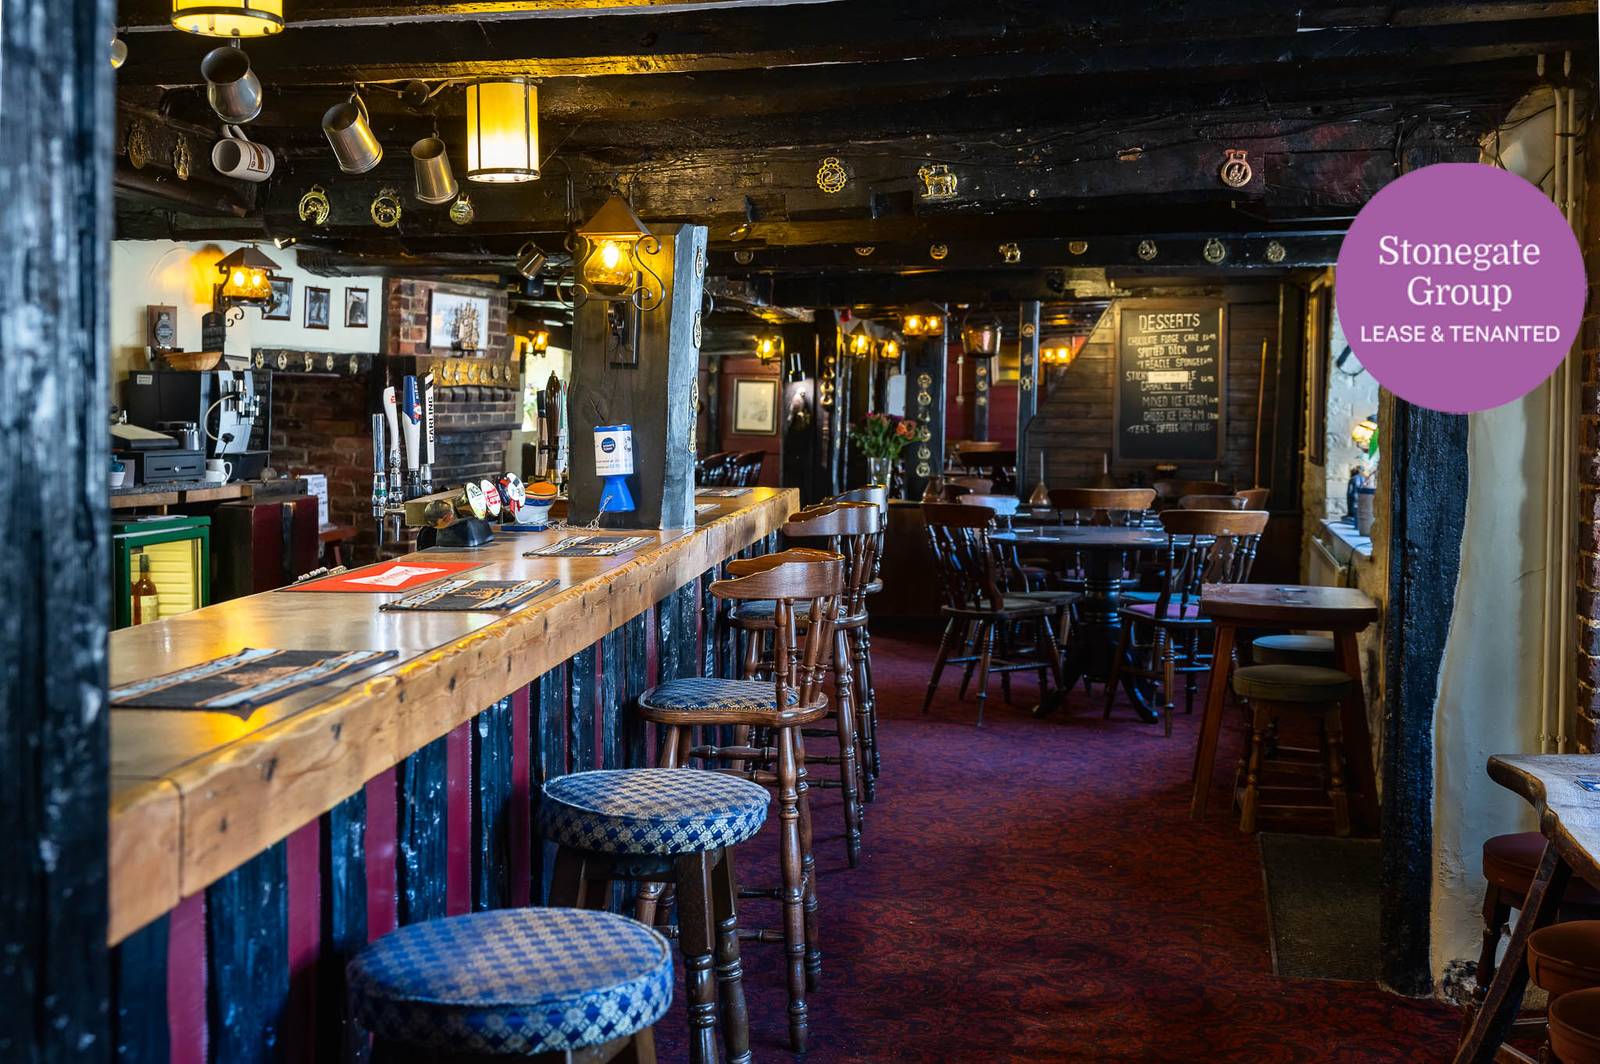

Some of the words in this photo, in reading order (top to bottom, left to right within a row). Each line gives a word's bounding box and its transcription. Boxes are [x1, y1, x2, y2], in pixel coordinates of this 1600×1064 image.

[1139, 313, 1200, 330] DESSERTS
[1168, 344, 1188, 355] DICK
[1171, 394, 1184, 407] ICE
[1185, 393, 1208, 406] CREAM
[427, 396, 435, 443] CARLING
